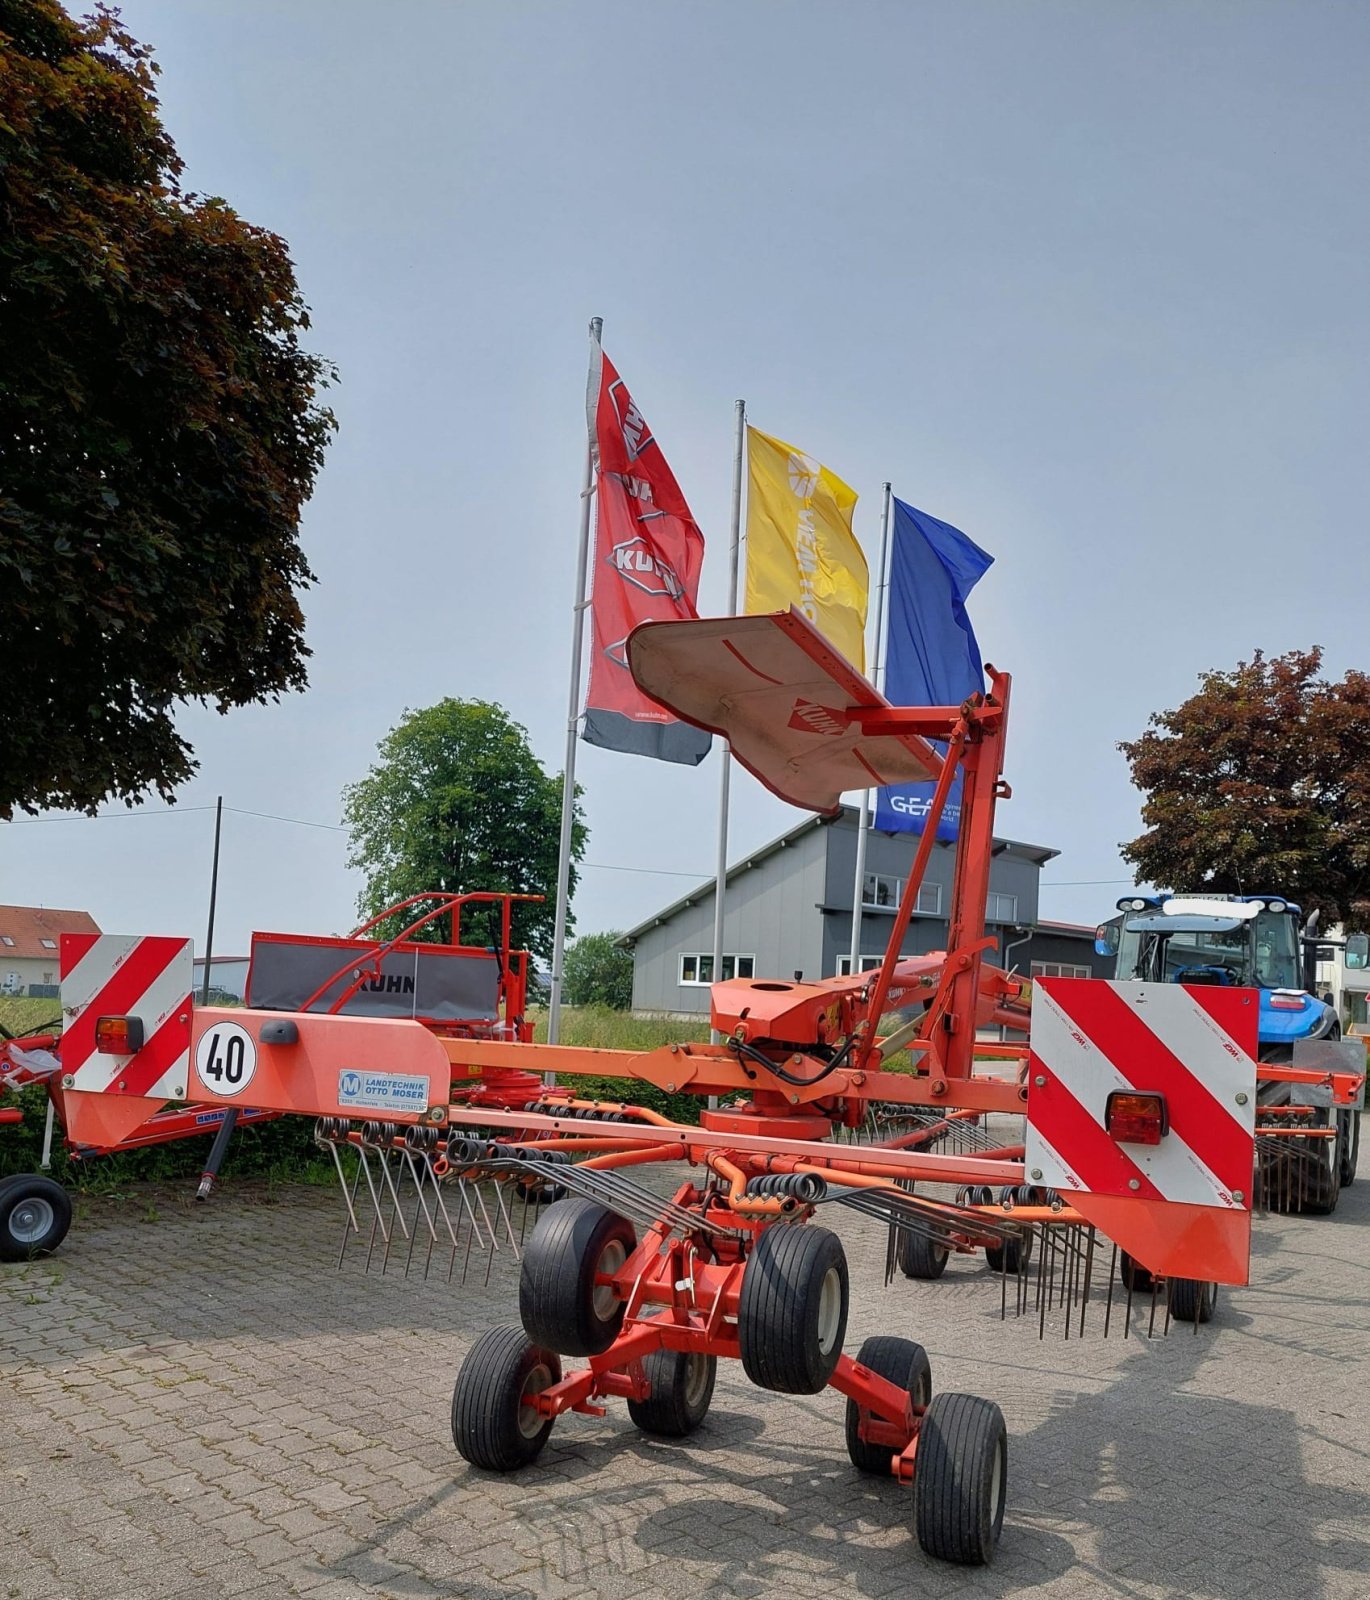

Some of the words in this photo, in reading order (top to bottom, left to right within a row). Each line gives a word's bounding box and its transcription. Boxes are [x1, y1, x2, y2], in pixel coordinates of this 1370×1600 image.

[793, 703, 846, 736] KUHN
[1222, 1042, 1239, 1058] WGF
[206, 1034, 245, 1084] 40
[365, 1079, 425, 1091] LANDTECHNIK
[365, 1087, 388, 1096] OTTO
[392, 1088, 424, 1099] MOSER
[1217, 1191, 1233, 1207] WGF
